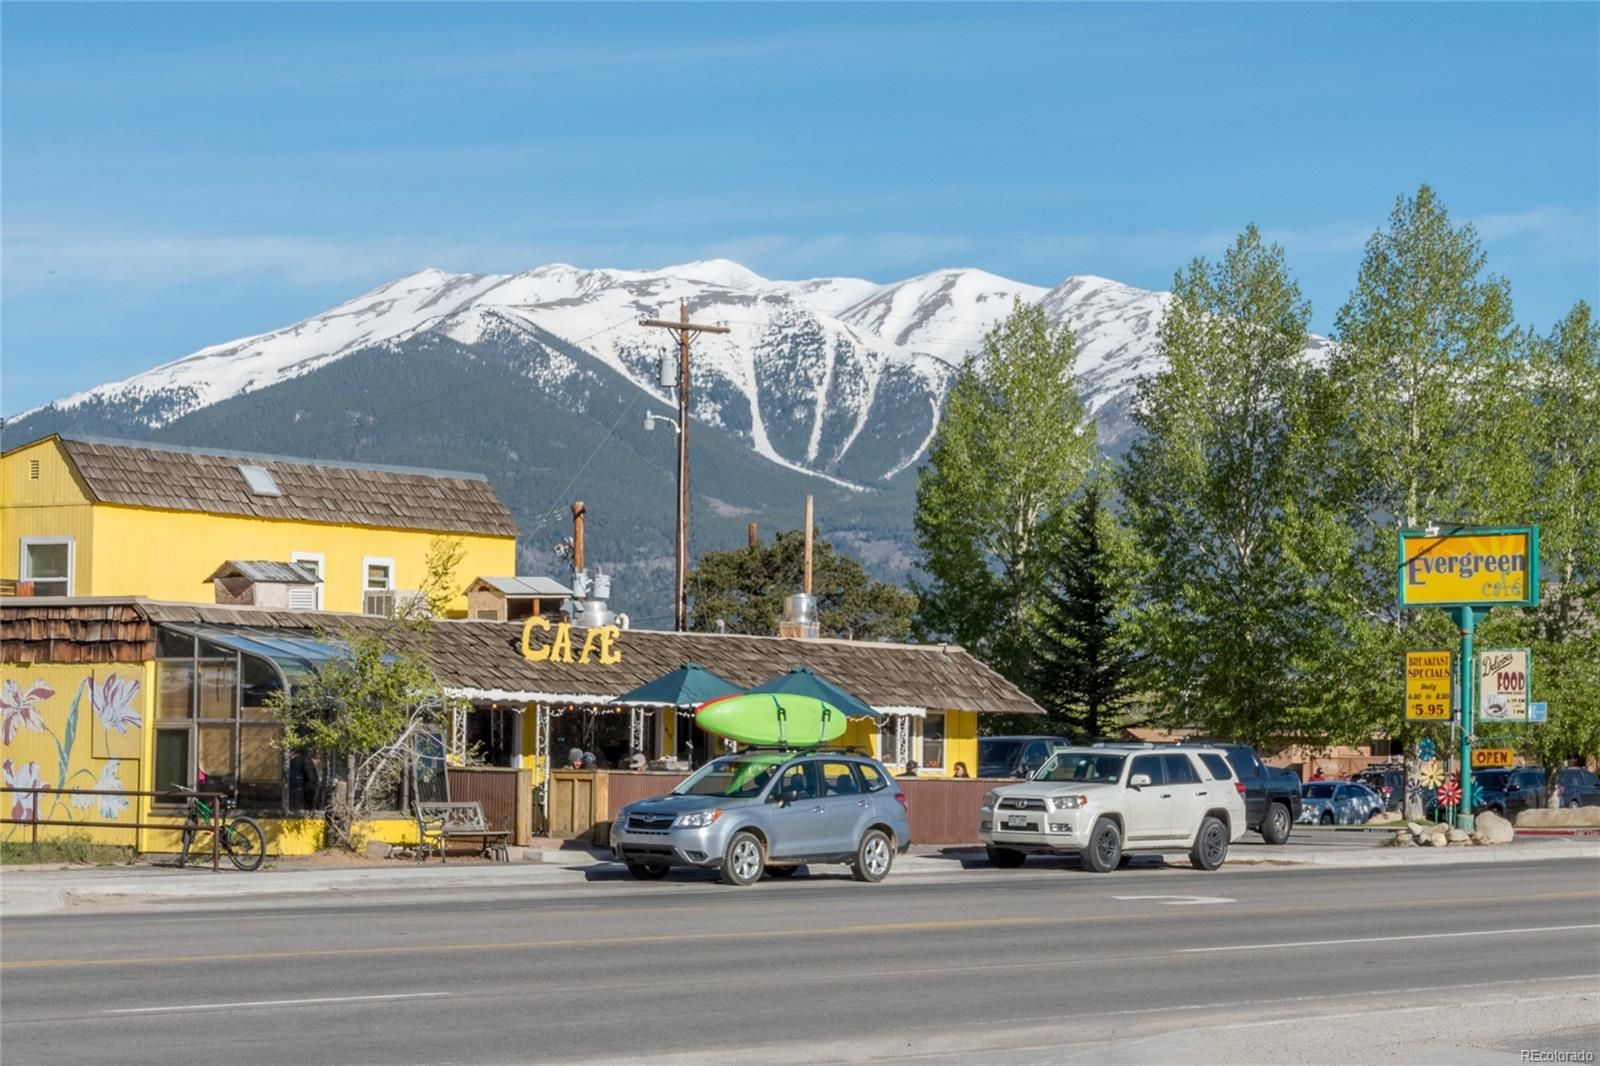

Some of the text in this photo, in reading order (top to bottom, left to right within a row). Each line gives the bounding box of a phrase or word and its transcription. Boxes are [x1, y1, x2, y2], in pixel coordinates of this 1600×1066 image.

[1409, 552, 1526, 585] Evergreen
[521, 615, 621, 664] CAFE
[1408, 656, 1449, 666] BREAKFAST
[1408, 669, 1450, 678] SPECIALS
[1497, 671, 1525, 691] FOOD
[1477, 751, 1508, 763] OPEN
